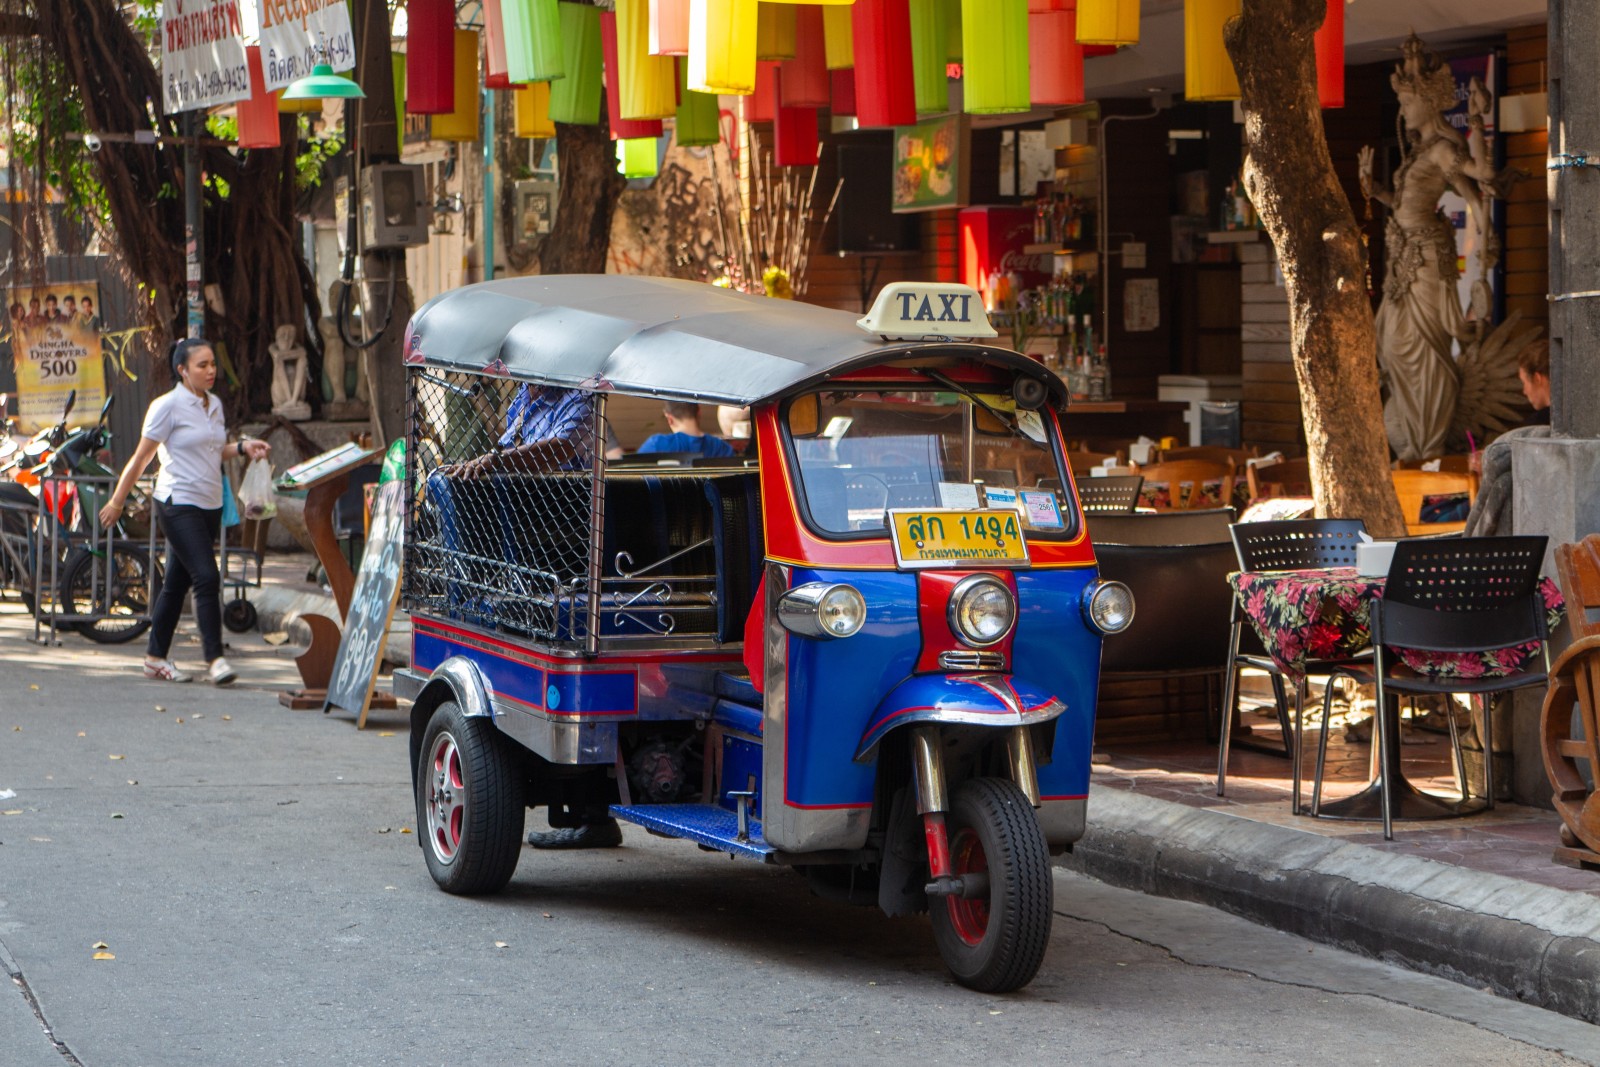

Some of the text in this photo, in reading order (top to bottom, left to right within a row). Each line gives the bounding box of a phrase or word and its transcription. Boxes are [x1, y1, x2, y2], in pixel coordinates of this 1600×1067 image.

[896, 292, 972, 322] TAXI
[38, 340, 75, 349] SINGHA
[40, 359, 77, 379] 500
[959, 516, 1018, 541] 1494
[919, 547, 1008, 559] กรุงเทพมหานคร
